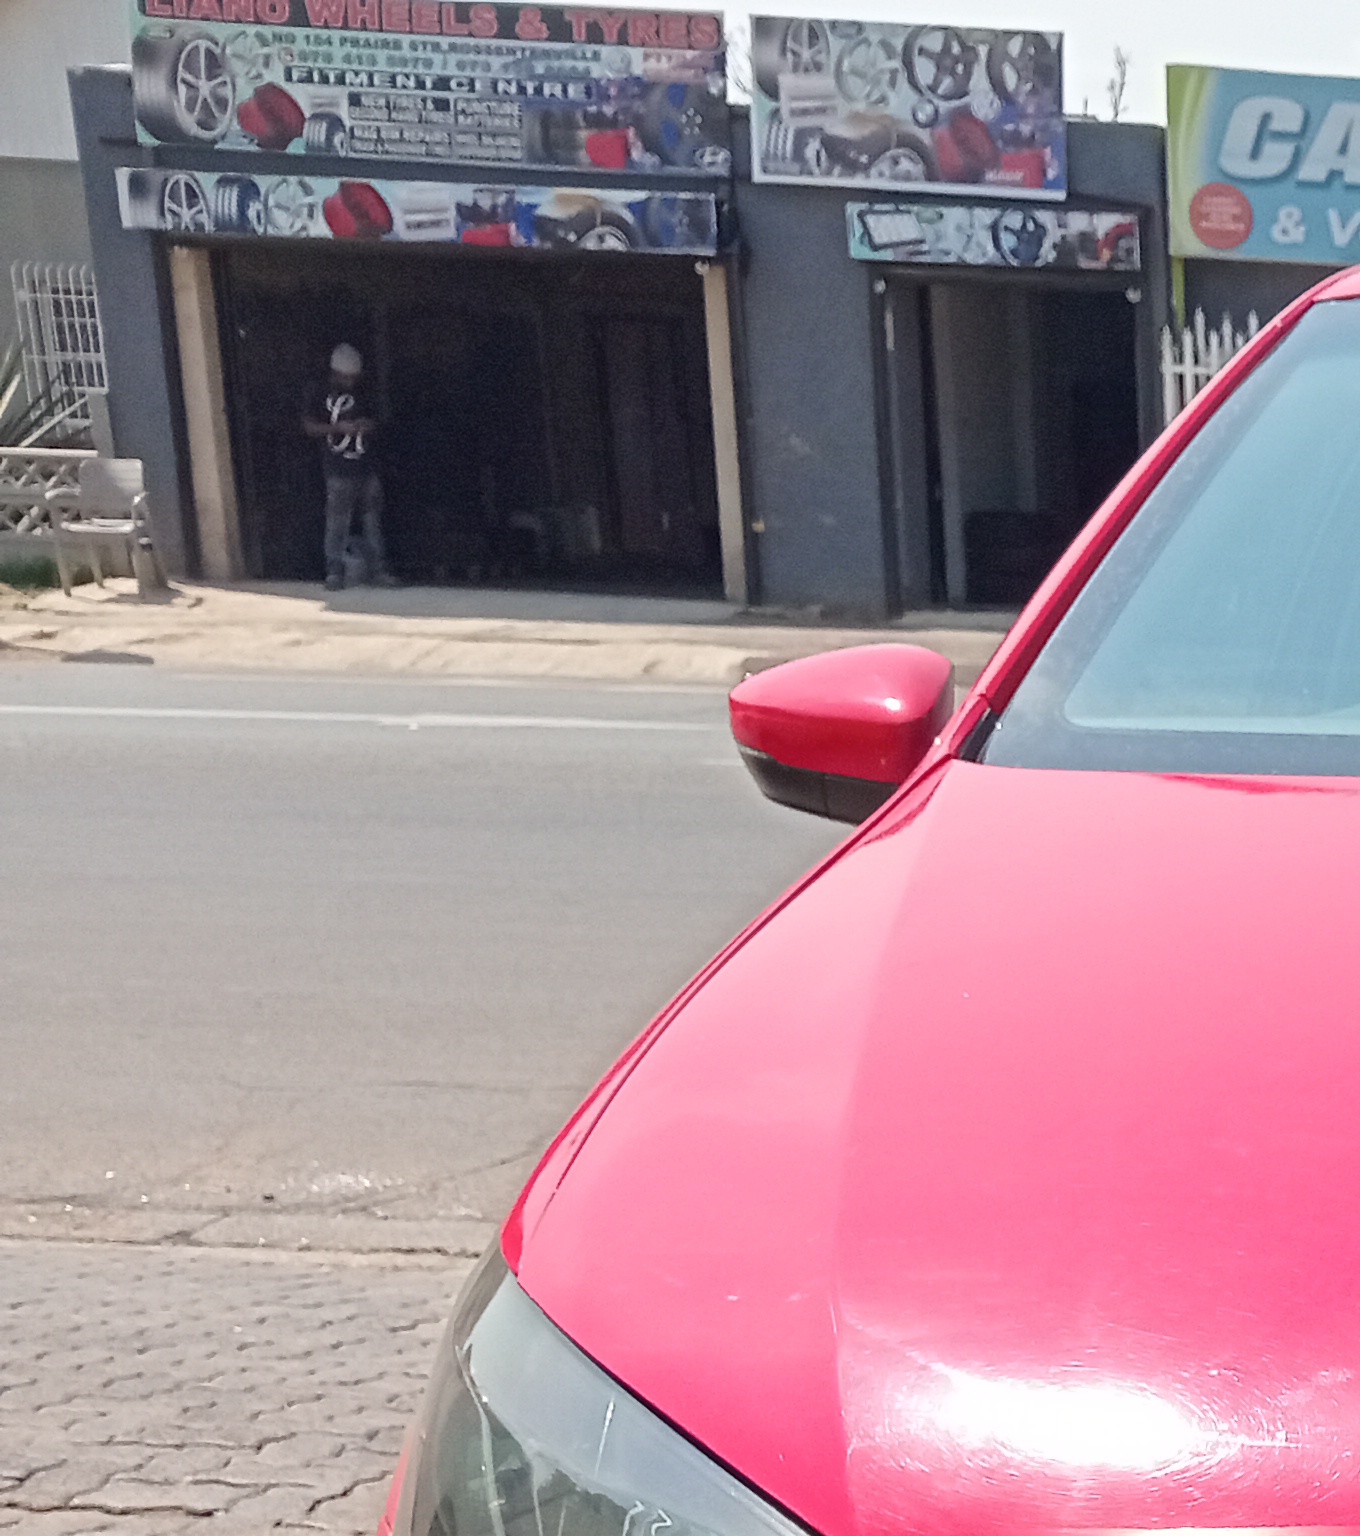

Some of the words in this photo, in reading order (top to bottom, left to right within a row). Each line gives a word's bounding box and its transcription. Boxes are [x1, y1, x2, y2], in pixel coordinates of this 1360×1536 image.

[305, 0, 498, 38] WHEELS
[516, 8, 549, 40] &
[564, 10, 720, 49] TYRES
[291, 67, 437, 90] FITMENT
[1272, 206, 1305, 243] &
